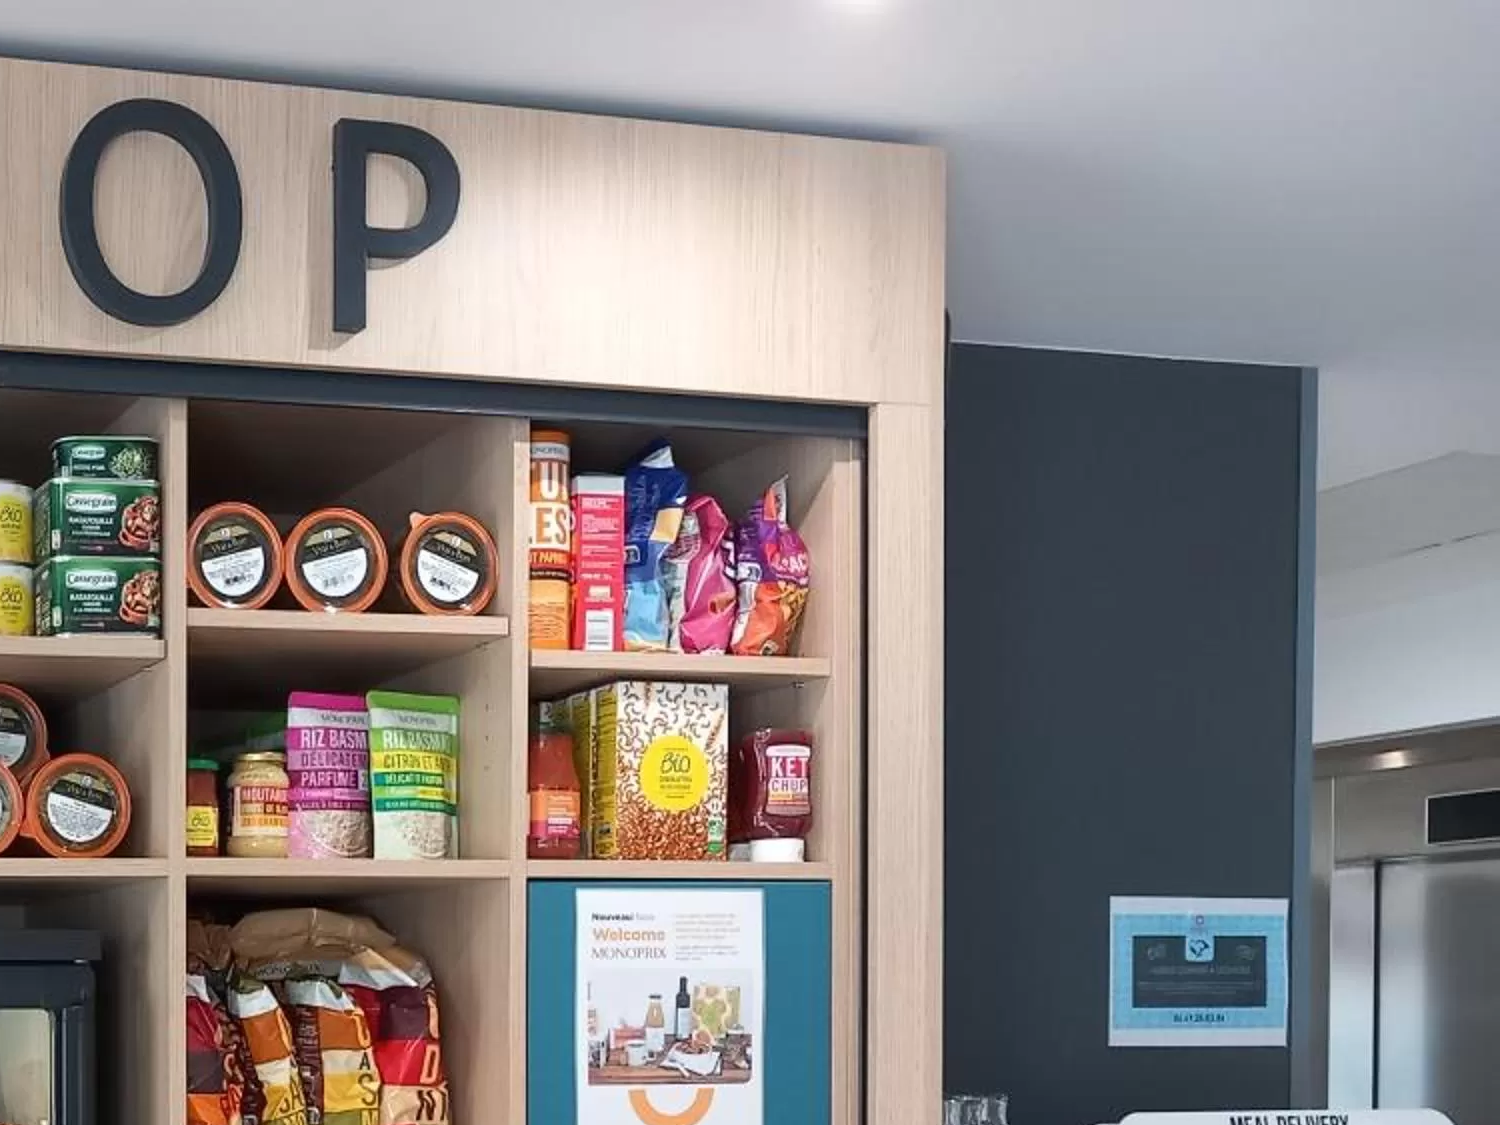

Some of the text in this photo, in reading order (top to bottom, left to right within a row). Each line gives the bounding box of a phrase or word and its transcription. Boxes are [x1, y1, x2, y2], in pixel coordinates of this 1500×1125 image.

[67, 573, 117, 587] Cassegrain
[301, 729, 327, 749] RIZ
[661, 752, 691, 774] Bio
[772, 757, 809, 778] KET
[772, 779, 808, 793] CHUP
[593, 927, 666, 941] Welcome
[592, 948, 667, 959] MONOPRIX
